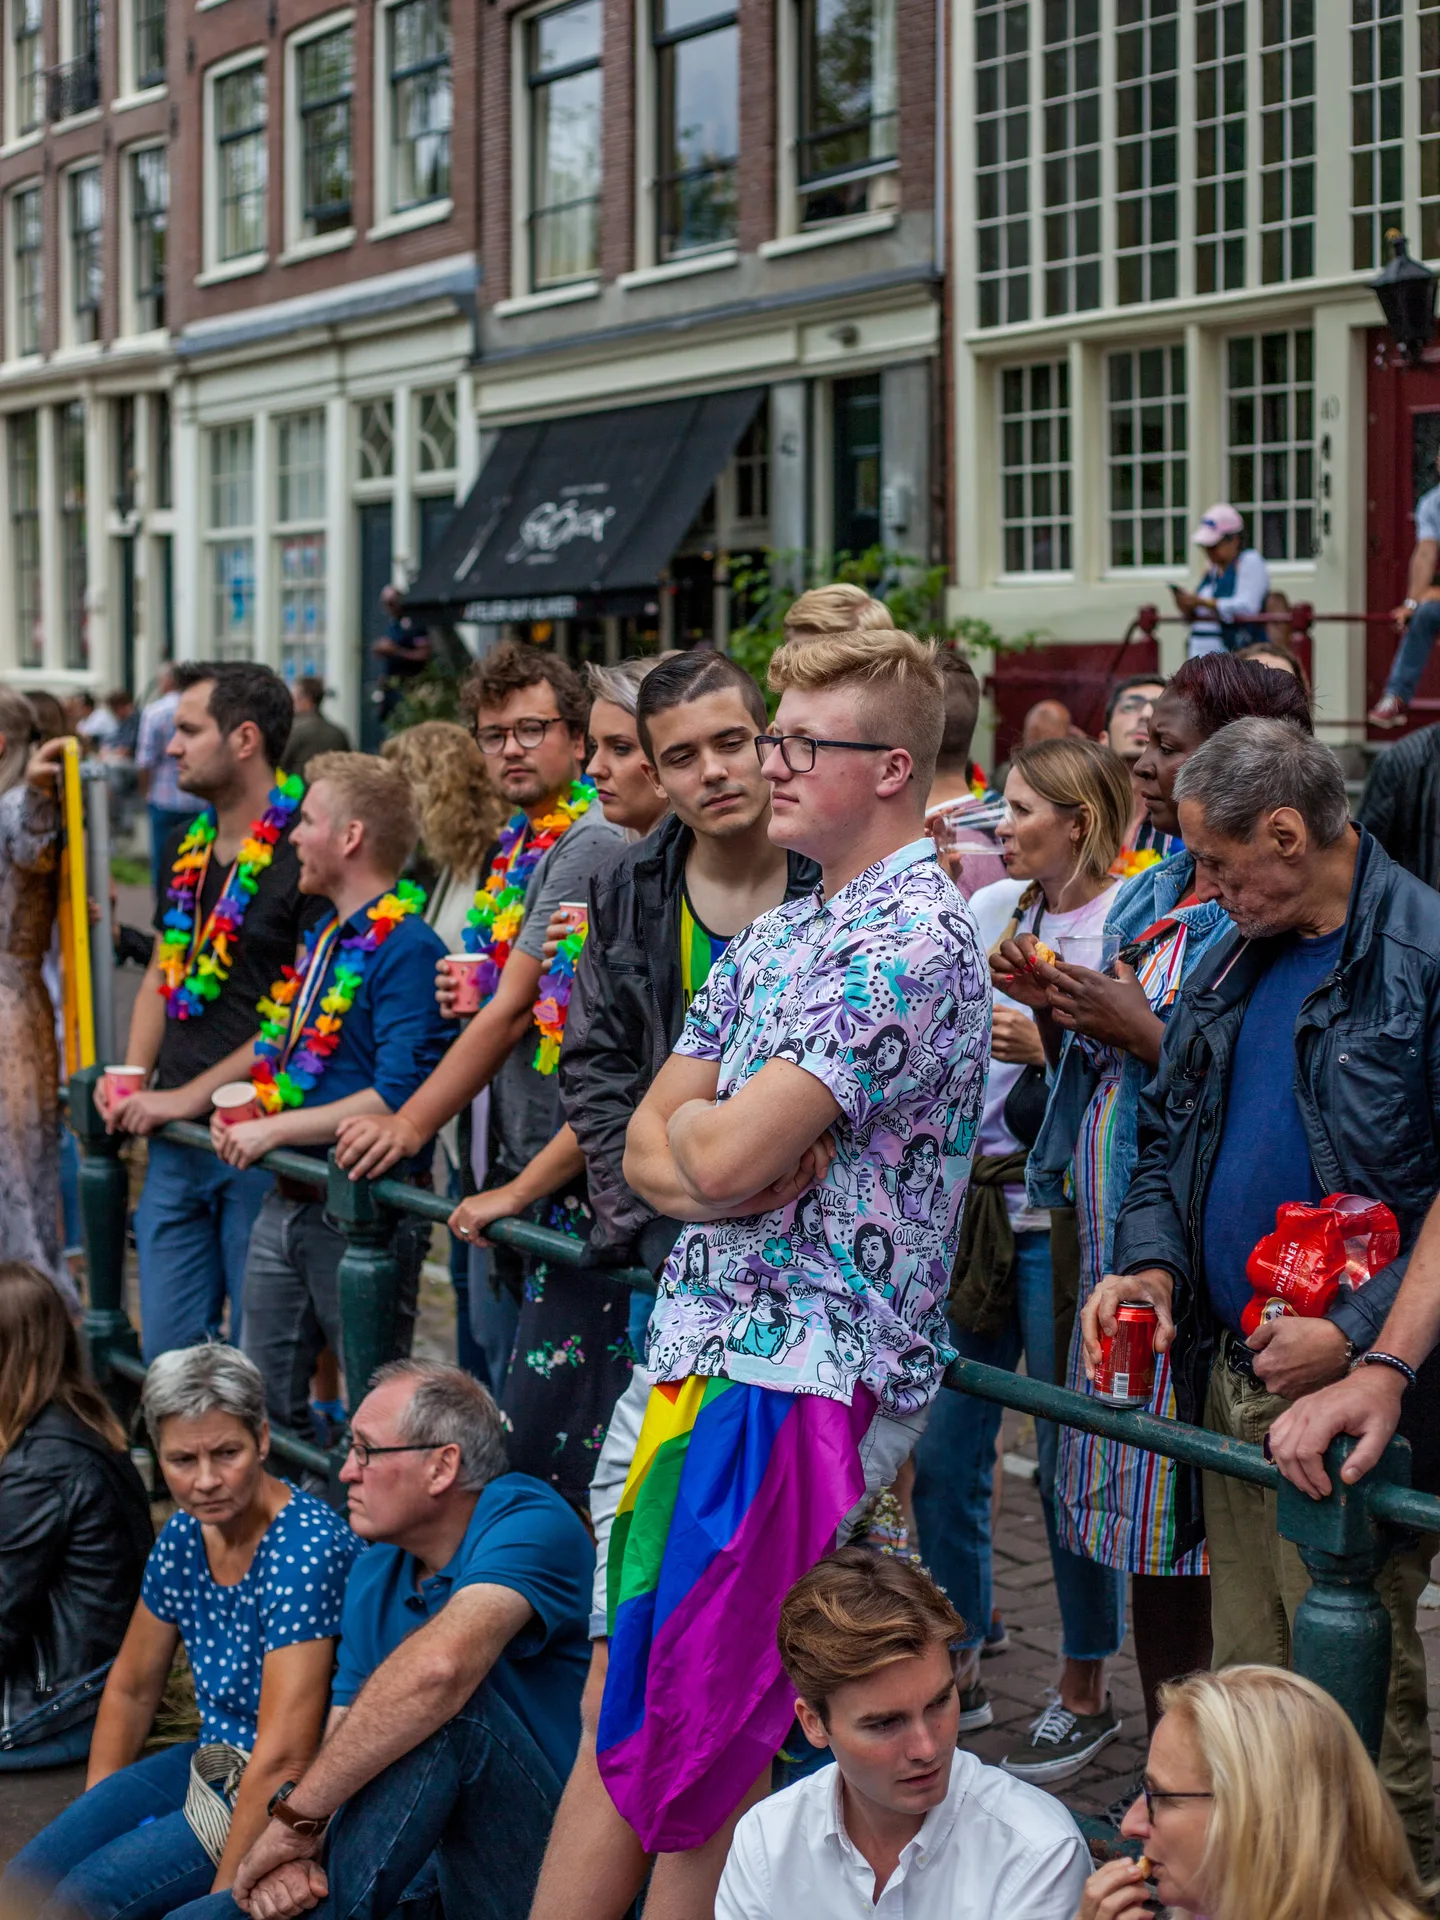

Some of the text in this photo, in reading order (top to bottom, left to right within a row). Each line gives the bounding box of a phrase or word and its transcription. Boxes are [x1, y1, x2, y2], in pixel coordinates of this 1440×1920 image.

[908, 1045, 941, 1080] OMG!
[822, 1208, 837, 1218] YOU
[708, 1228, 744, 1249] OMG!
[891, 1224, 930, 1247] OMG!
[717, 1248, 729, 1257] YOU
[905, 1248, 915, 1257] YOU
[1275, 1241, 1300, 1294] PILSENER
